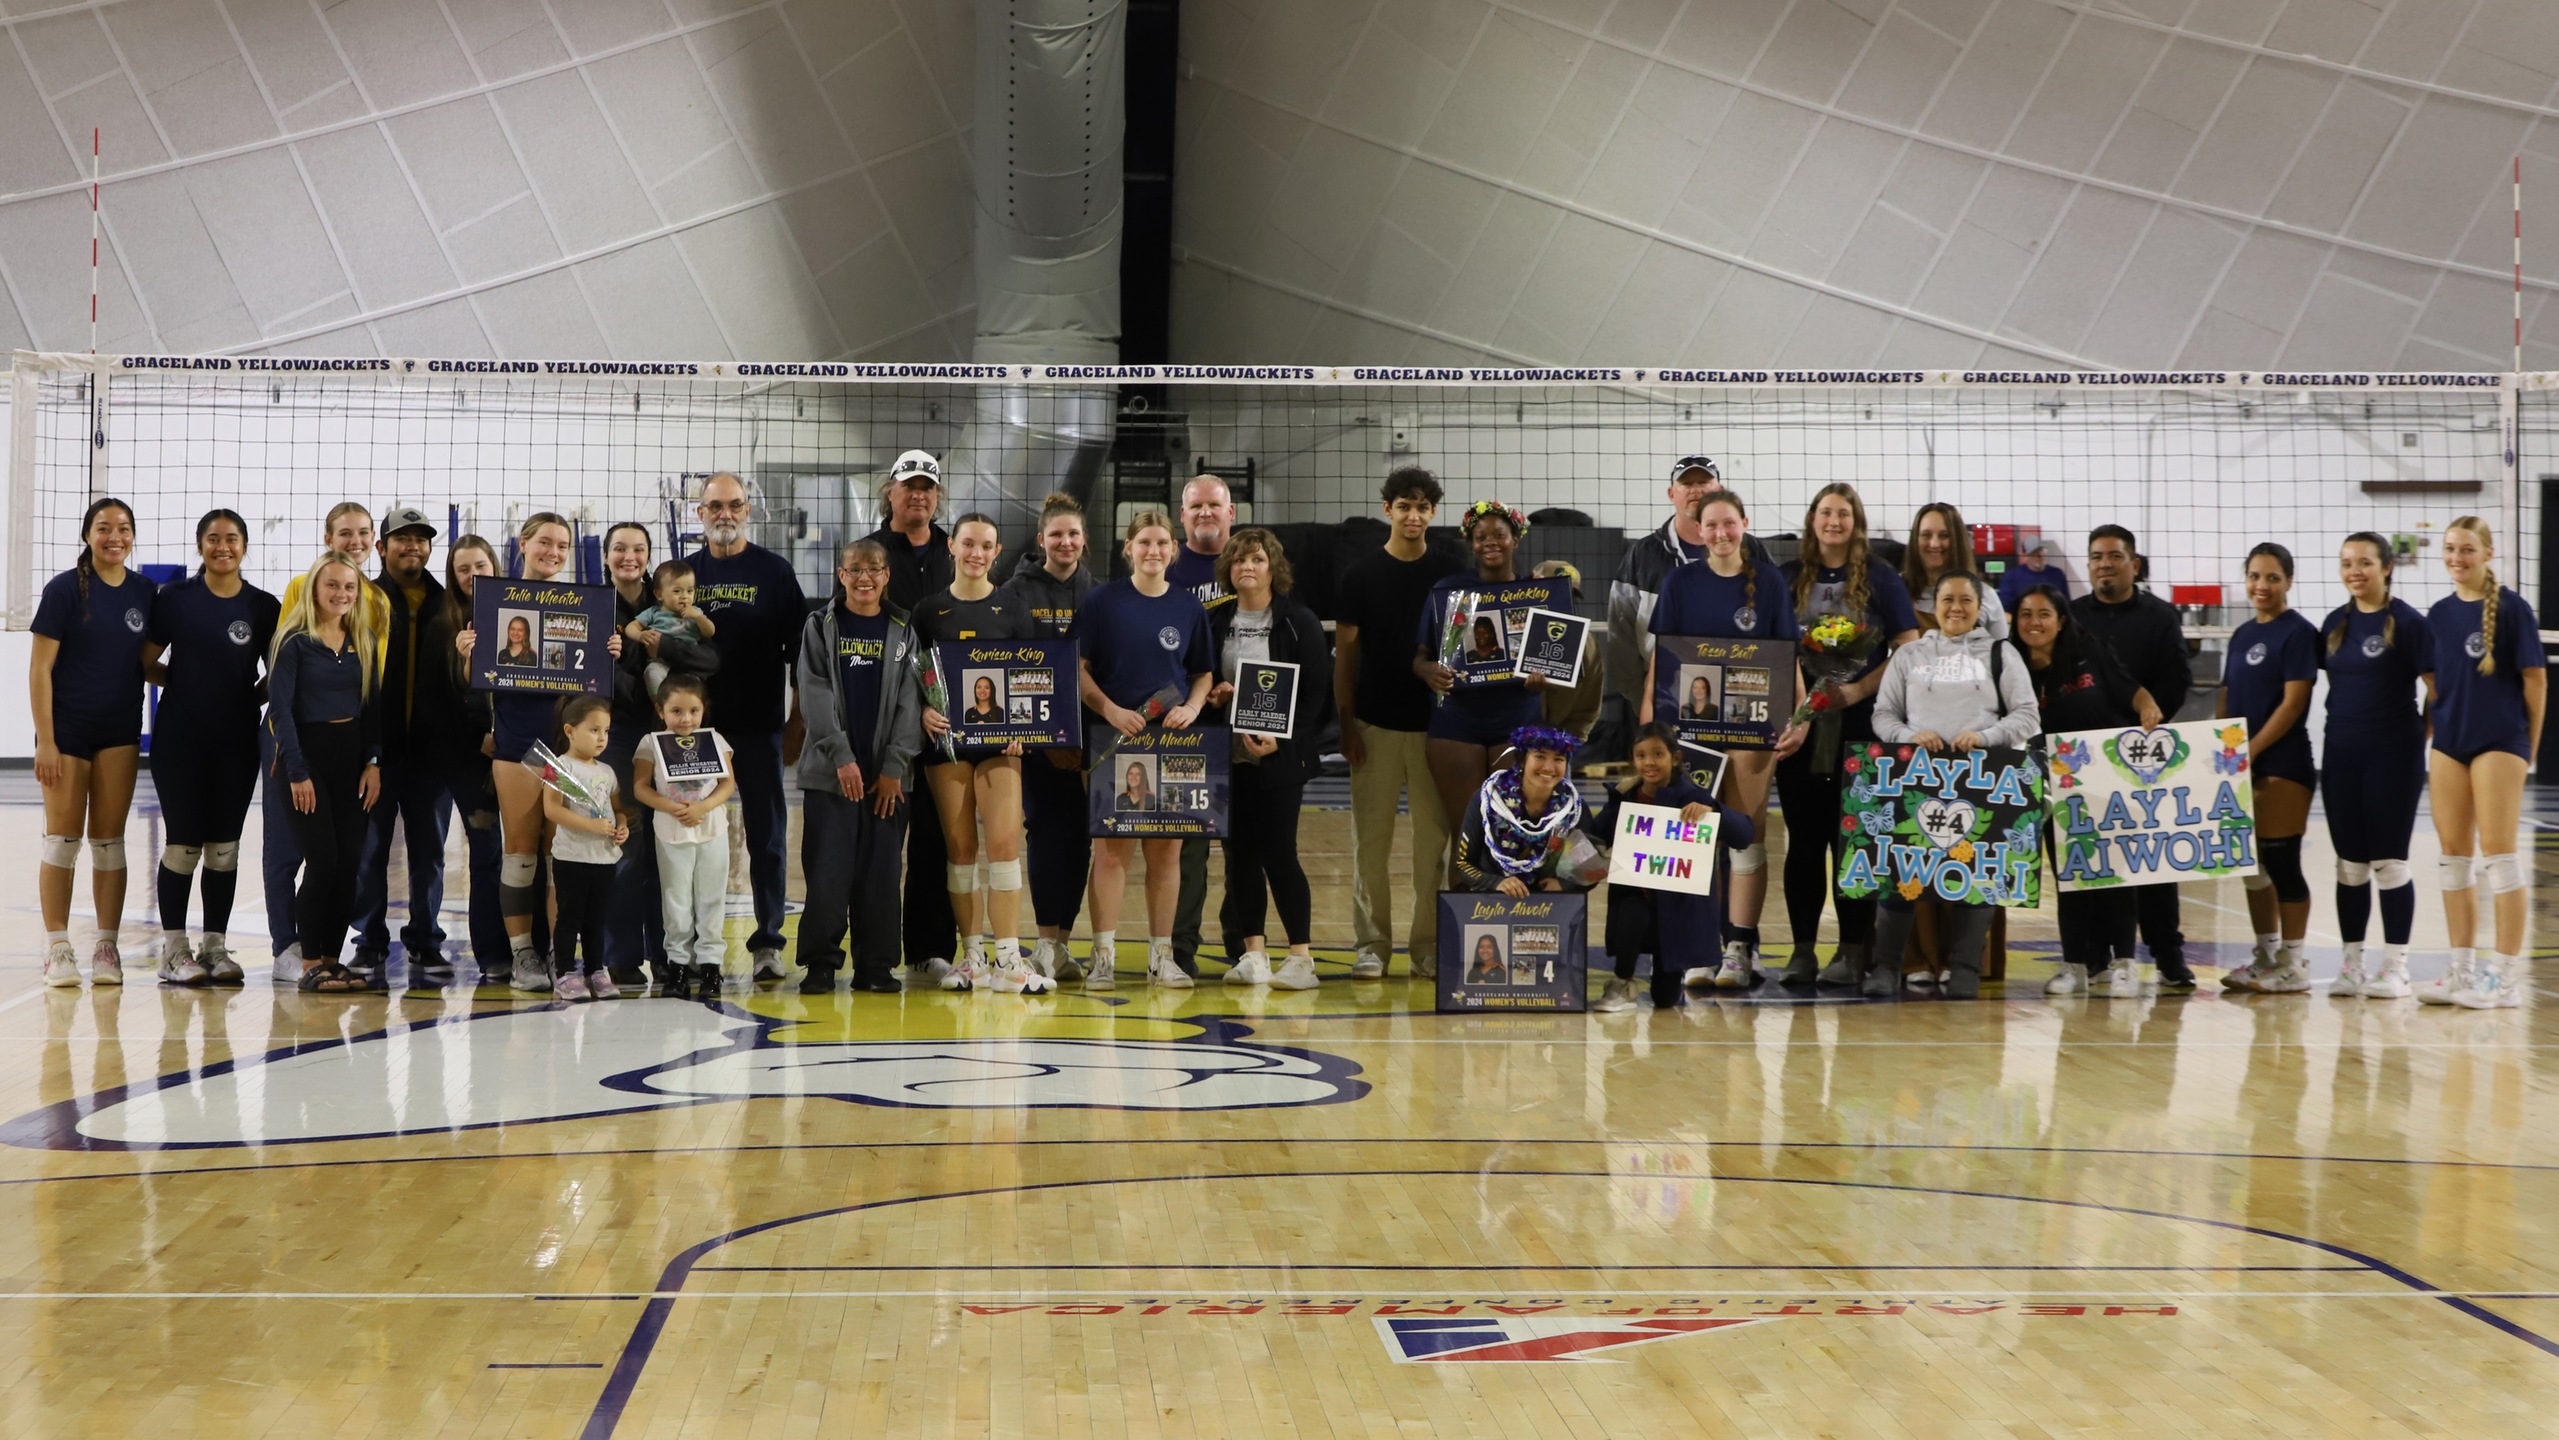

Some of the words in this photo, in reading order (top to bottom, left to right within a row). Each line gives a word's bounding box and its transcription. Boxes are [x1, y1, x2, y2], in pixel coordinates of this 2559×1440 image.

[122, 357, 232, 370] GRACELAND
[238, 358, 391, 371] YELLOWJACKETS
[428, 360, 539, 373] GRACELAND
[545, 361, 698, 375] YELLOWJACKETS
[737, 364, 849, 376] GRACELAND
[854, 364, 1007, 378] YELLOWJACKETS
[1045, 366, 1156, 378] GRACELAND
[1162, 367, 1314, 379] YELLOWJACKETS
[1353, 368, 1464, 381] GRACELAND
[1469, 369, 1621, 381] YELLOWJACKETS
[1659, 370, 1768, 382] GRACELAND
[1774, 371, 1924, 383] YELLOWJACKETS
[1963, 372, 2071, 384] GRACELAND
[2077, 372, 2226, 384] YELLOWJACKETS
[2263, 373, 2370, 385] GRACELAND
[2376, 375, 2500, 387] YELLOWJACKE
[503, 586, 532, 602] Julie
[535, 587, 584, 606] Wheaton
[1500, 586, 1550, 605] Quickley
[710, 600, 732, 612] Dad
[968, 648, 1013, 663] Karissa
[1015, 647, 1045, 666] King
[1539, 641, 1565, 660] 16
[574, 648, 585, 670] 2
[849, 655, 873, 667] Mom
[1936, 653, 1961, 665] THE
[1470, 674, 1485, 683] 2024
[1523, 665, 1551, 675] SENIOR
[1552, 669, 1571, 679] 2024
[498, 678, 514, 687] 2024
[515, 679, 545, 689] WOMEN'S
[546, 681, 584, 691] VOLLEYBALL
[1252, 692, 1277, 711] 15
[1039, 700, 1050, 721] 5
[1749, 701, 1768, 722] 15
[1266, 722, 1286, 730] 2024
[966, 736, 982, 745] 2024
[983, 735, 1014, 744] WOMEN'S
[1015, 735, 1054, 744] VOLLEYBALL
[1159, 732, 1204, 748] Maedel
[1680, 732, 1696, 740] 2024
[1697, 732, 1726, 741] WOMEN'S
[1727, 735, 1765, 744] VOLLEYBALL
[2129, 740, 2167, 763] #4
[1875, 746, 2028, 806] LAYLA
[1190, 789, 1209, 810] 15
[2066, 780, 2246, 835] LAYLA
[1117, 824, 1132, 832] 2024
[1133, 824, 1164, 832] WOMEN'S
[1165, 824, 1203, 833] VOLLEYBALL
[1926, 809, 1965, 834] #4
[1626, 814, 1654, 837] IM
[1665, 820, 1713, 844] HER
[2058, 828, 2255, 881] AIWOHI
[1633, 852, 1692, 879] TWIN
[1839, 835, 2029, 901] AIWOHI
[1471, 901, 1506, 920] Layla
[1510, 901, 1553, 918] Aiwohi
[1543, 960, 1555, 983] 4
[1466, 998, 1483, 1006] 2024
[1484, 998, 1515, 1006] WOMEN'S
[1516, 998, 1556, 1007] VOLLEYBALL
[959, 1305, 1569, 1316] AMERICA
[1592, 1307, 1713, 1315] OF
[1752, 1306, 2178, 1316] HEART
